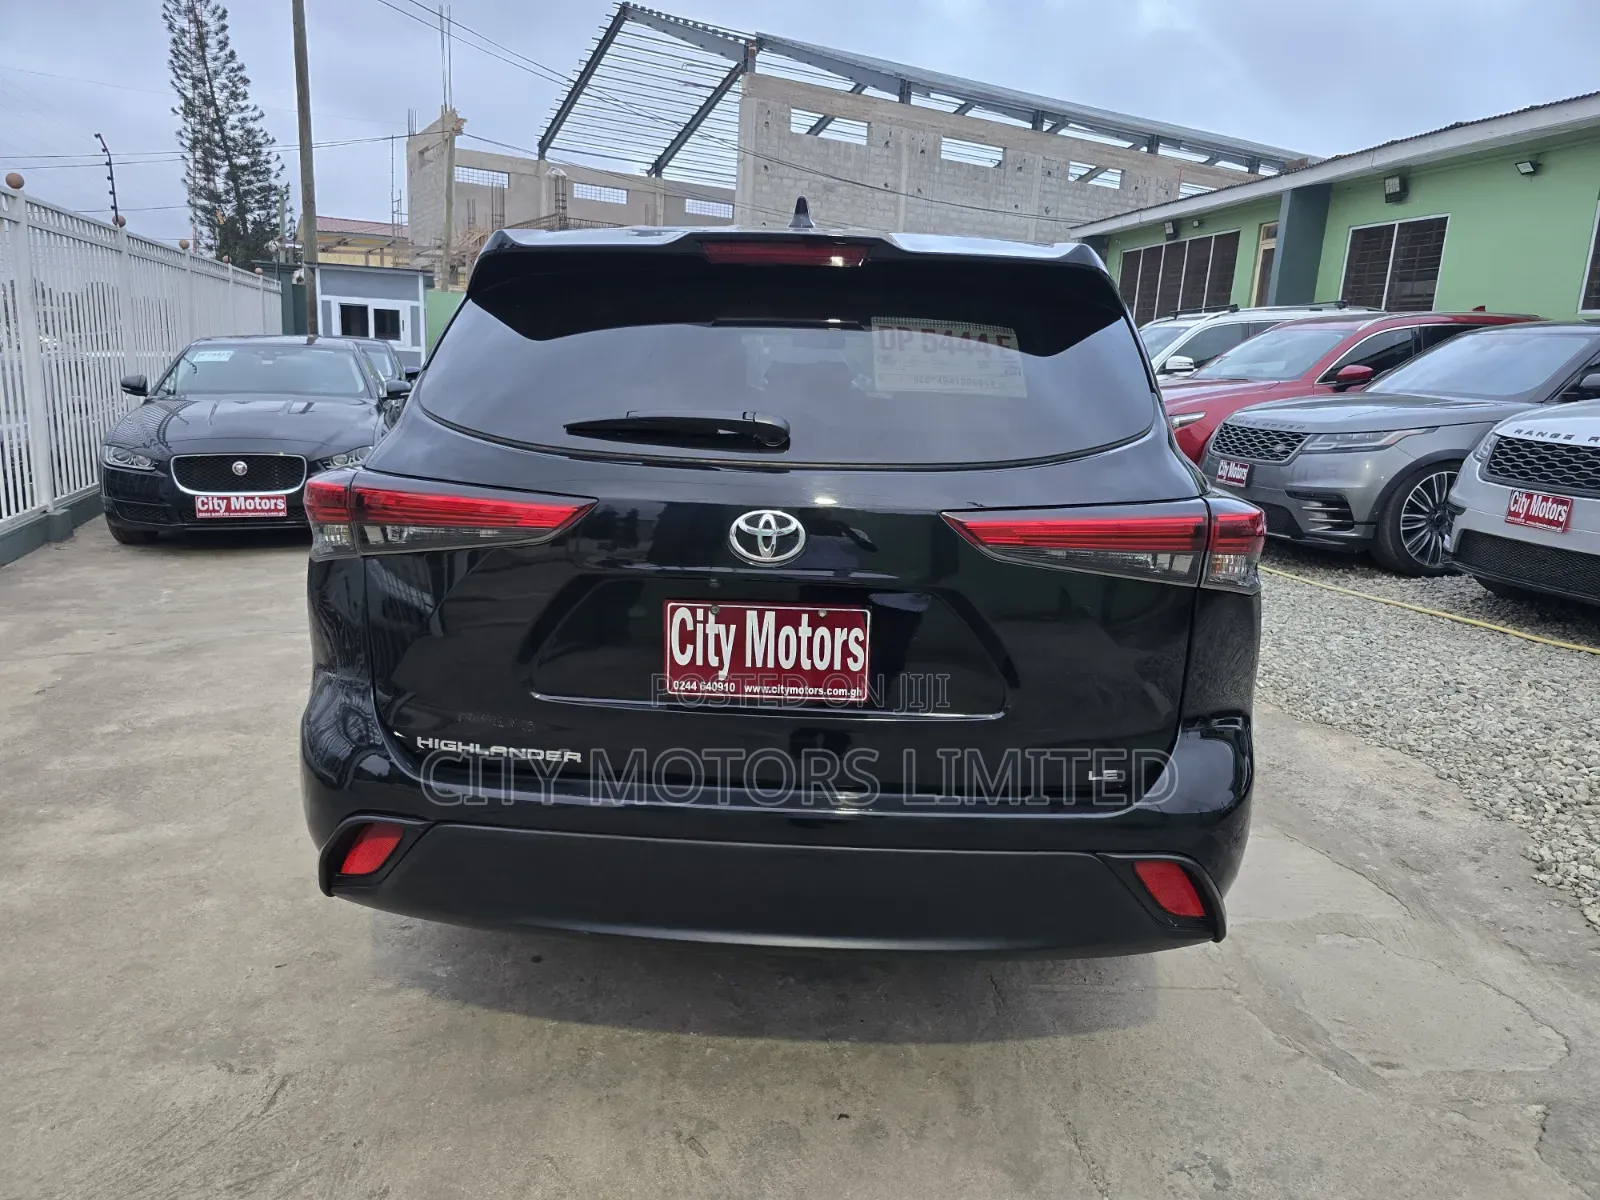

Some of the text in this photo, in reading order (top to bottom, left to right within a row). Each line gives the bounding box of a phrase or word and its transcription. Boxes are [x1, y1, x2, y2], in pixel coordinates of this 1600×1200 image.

[1514, 429, 1575, 440] RANGE
[197, 496, 285, 513] City Motors
[1510, 491, 1568, 522] City Motors
[671, 607, 865, 681] City Motors
[673, 680, 863, 698] 0244 640910 www.citymotors.com.gh
[416, 736, 582, 763] HIGHLANDER
[1088, 769, 1118, 780] LE
